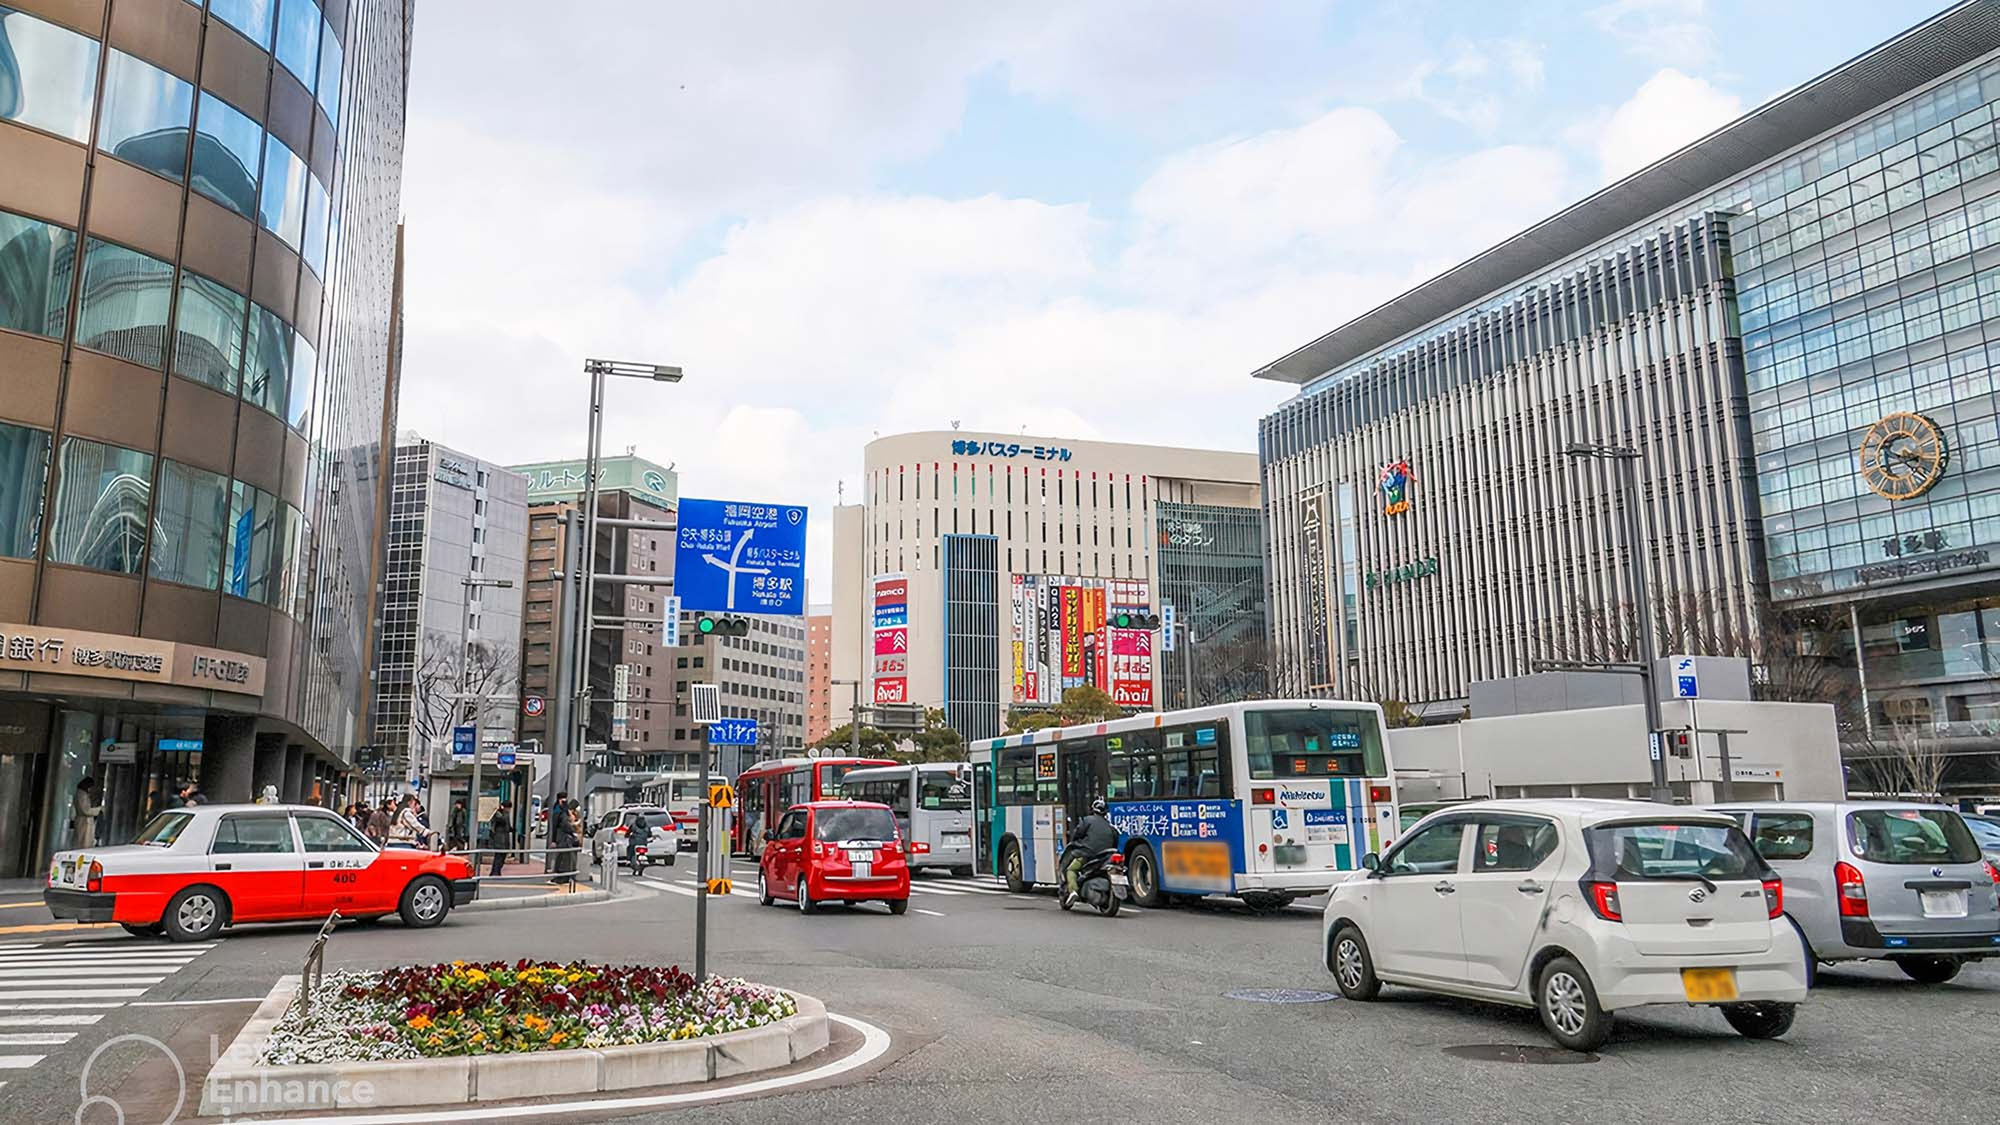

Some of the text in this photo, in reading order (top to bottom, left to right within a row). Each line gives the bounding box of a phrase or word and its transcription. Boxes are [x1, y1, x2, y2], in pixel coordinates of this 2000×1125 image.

[951, 439, 1073, 462] 博多バスターミナル
[723, 504, 778, 520] 福岡空港
[723, 517, 778, 528] Fukuoka Airport
[747, 547, 800, 561] 博多バスターミナル
[753, 577, 793, 592] 博多駅
[876, 684, 904, 702] Avail
[1115, 688, 1150, 702] Avail
